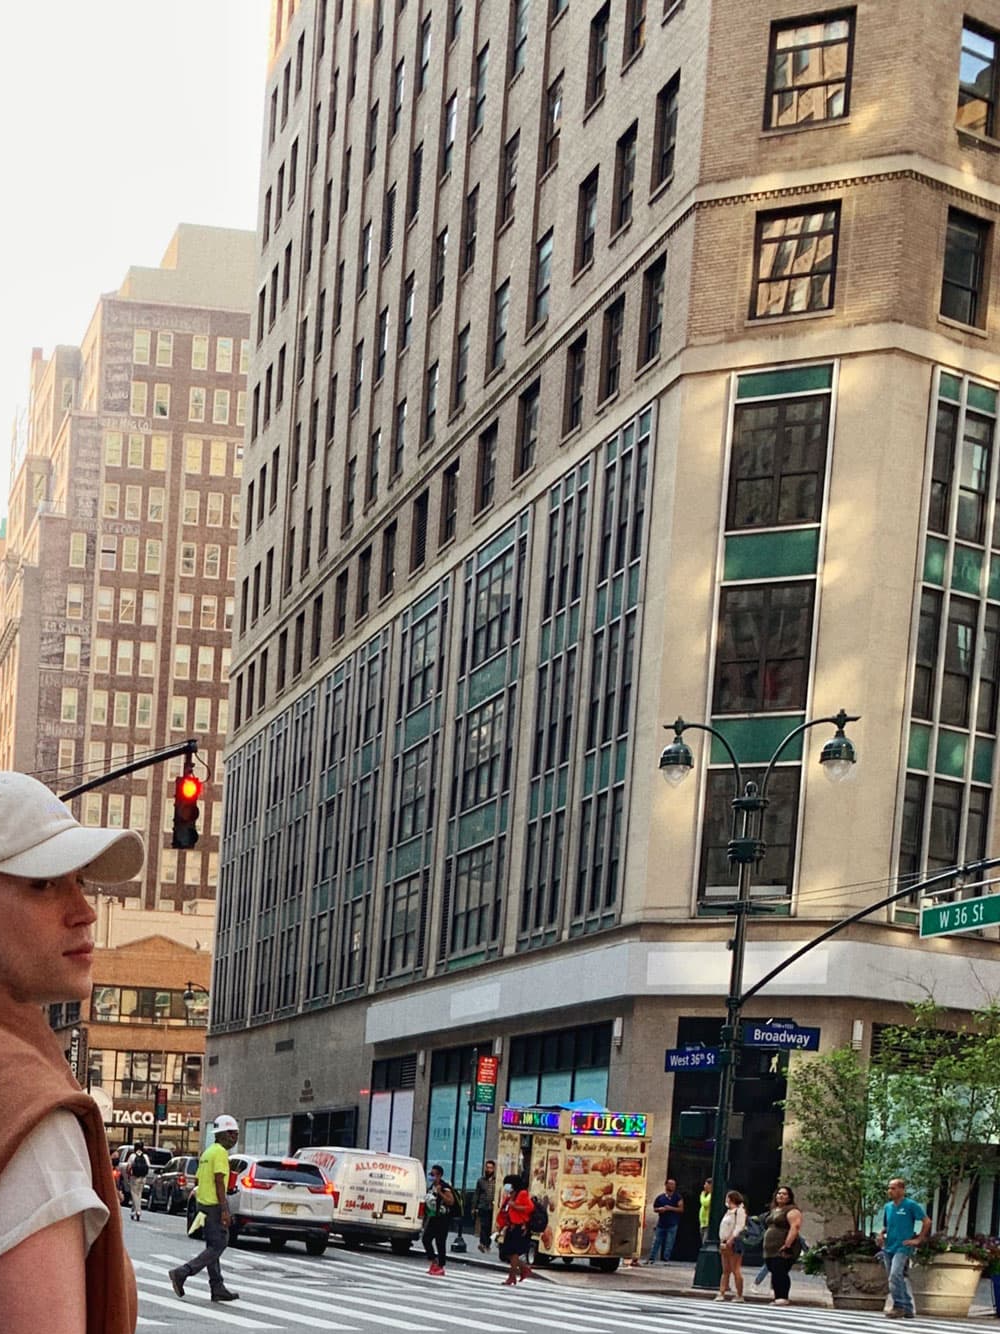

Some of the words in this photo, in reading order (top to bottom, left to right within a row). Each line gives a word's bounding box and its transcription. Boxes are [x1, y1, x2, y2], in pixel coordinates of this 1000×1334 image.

[939, 910, 950, 928] W
[954, 906, 968, 926] 36
[972, 902, 984, 922] St
[753, 1028, 810, 1047] Broadway
[670, 1054, 689, 1066] West
[706, 1052, 715, 1065] St
[113, 1110, 154, 1124] TACO
[158, 1112, 188, 1126] EL
[582, 1114, 645, 1132] JUICES
